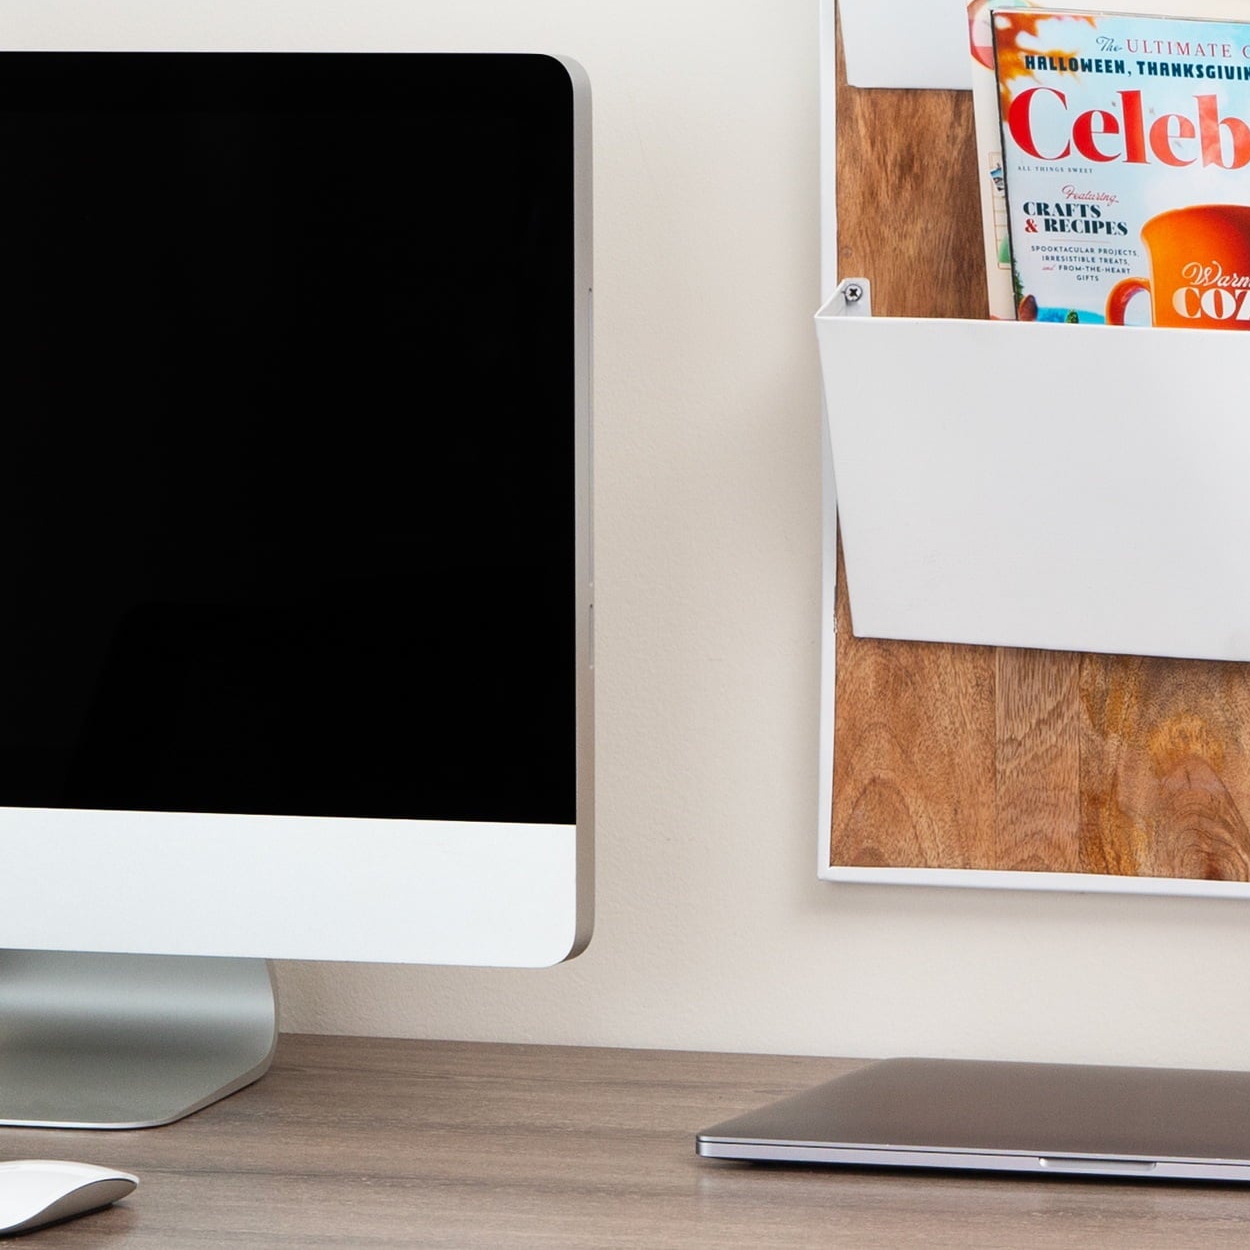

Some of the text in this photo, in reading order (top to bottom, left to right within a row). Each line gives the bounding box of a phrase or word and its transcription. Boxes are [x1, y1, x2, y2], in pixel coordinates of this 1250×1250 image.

[1095, 36, 1123, 52] The
[1126, 39, 1233, 58] ULTIMATE
[1024, 54, 1132, 77] HALLOWEEN,
[1061, 184, 1119, 206] Featuring
[1023, 201, 1102, 218] CRAFTS
[1025, 218, 1128, 236] & RECIPES
[1031, 245, 1095, 254] SPOOKTACULAR
[1042, 255, 1096, 263] IRRESISTIBLE
[1058, 264, 1131, 274] FROM-THE-HEART
[1076, 274, 1099, 282] GIFTS
